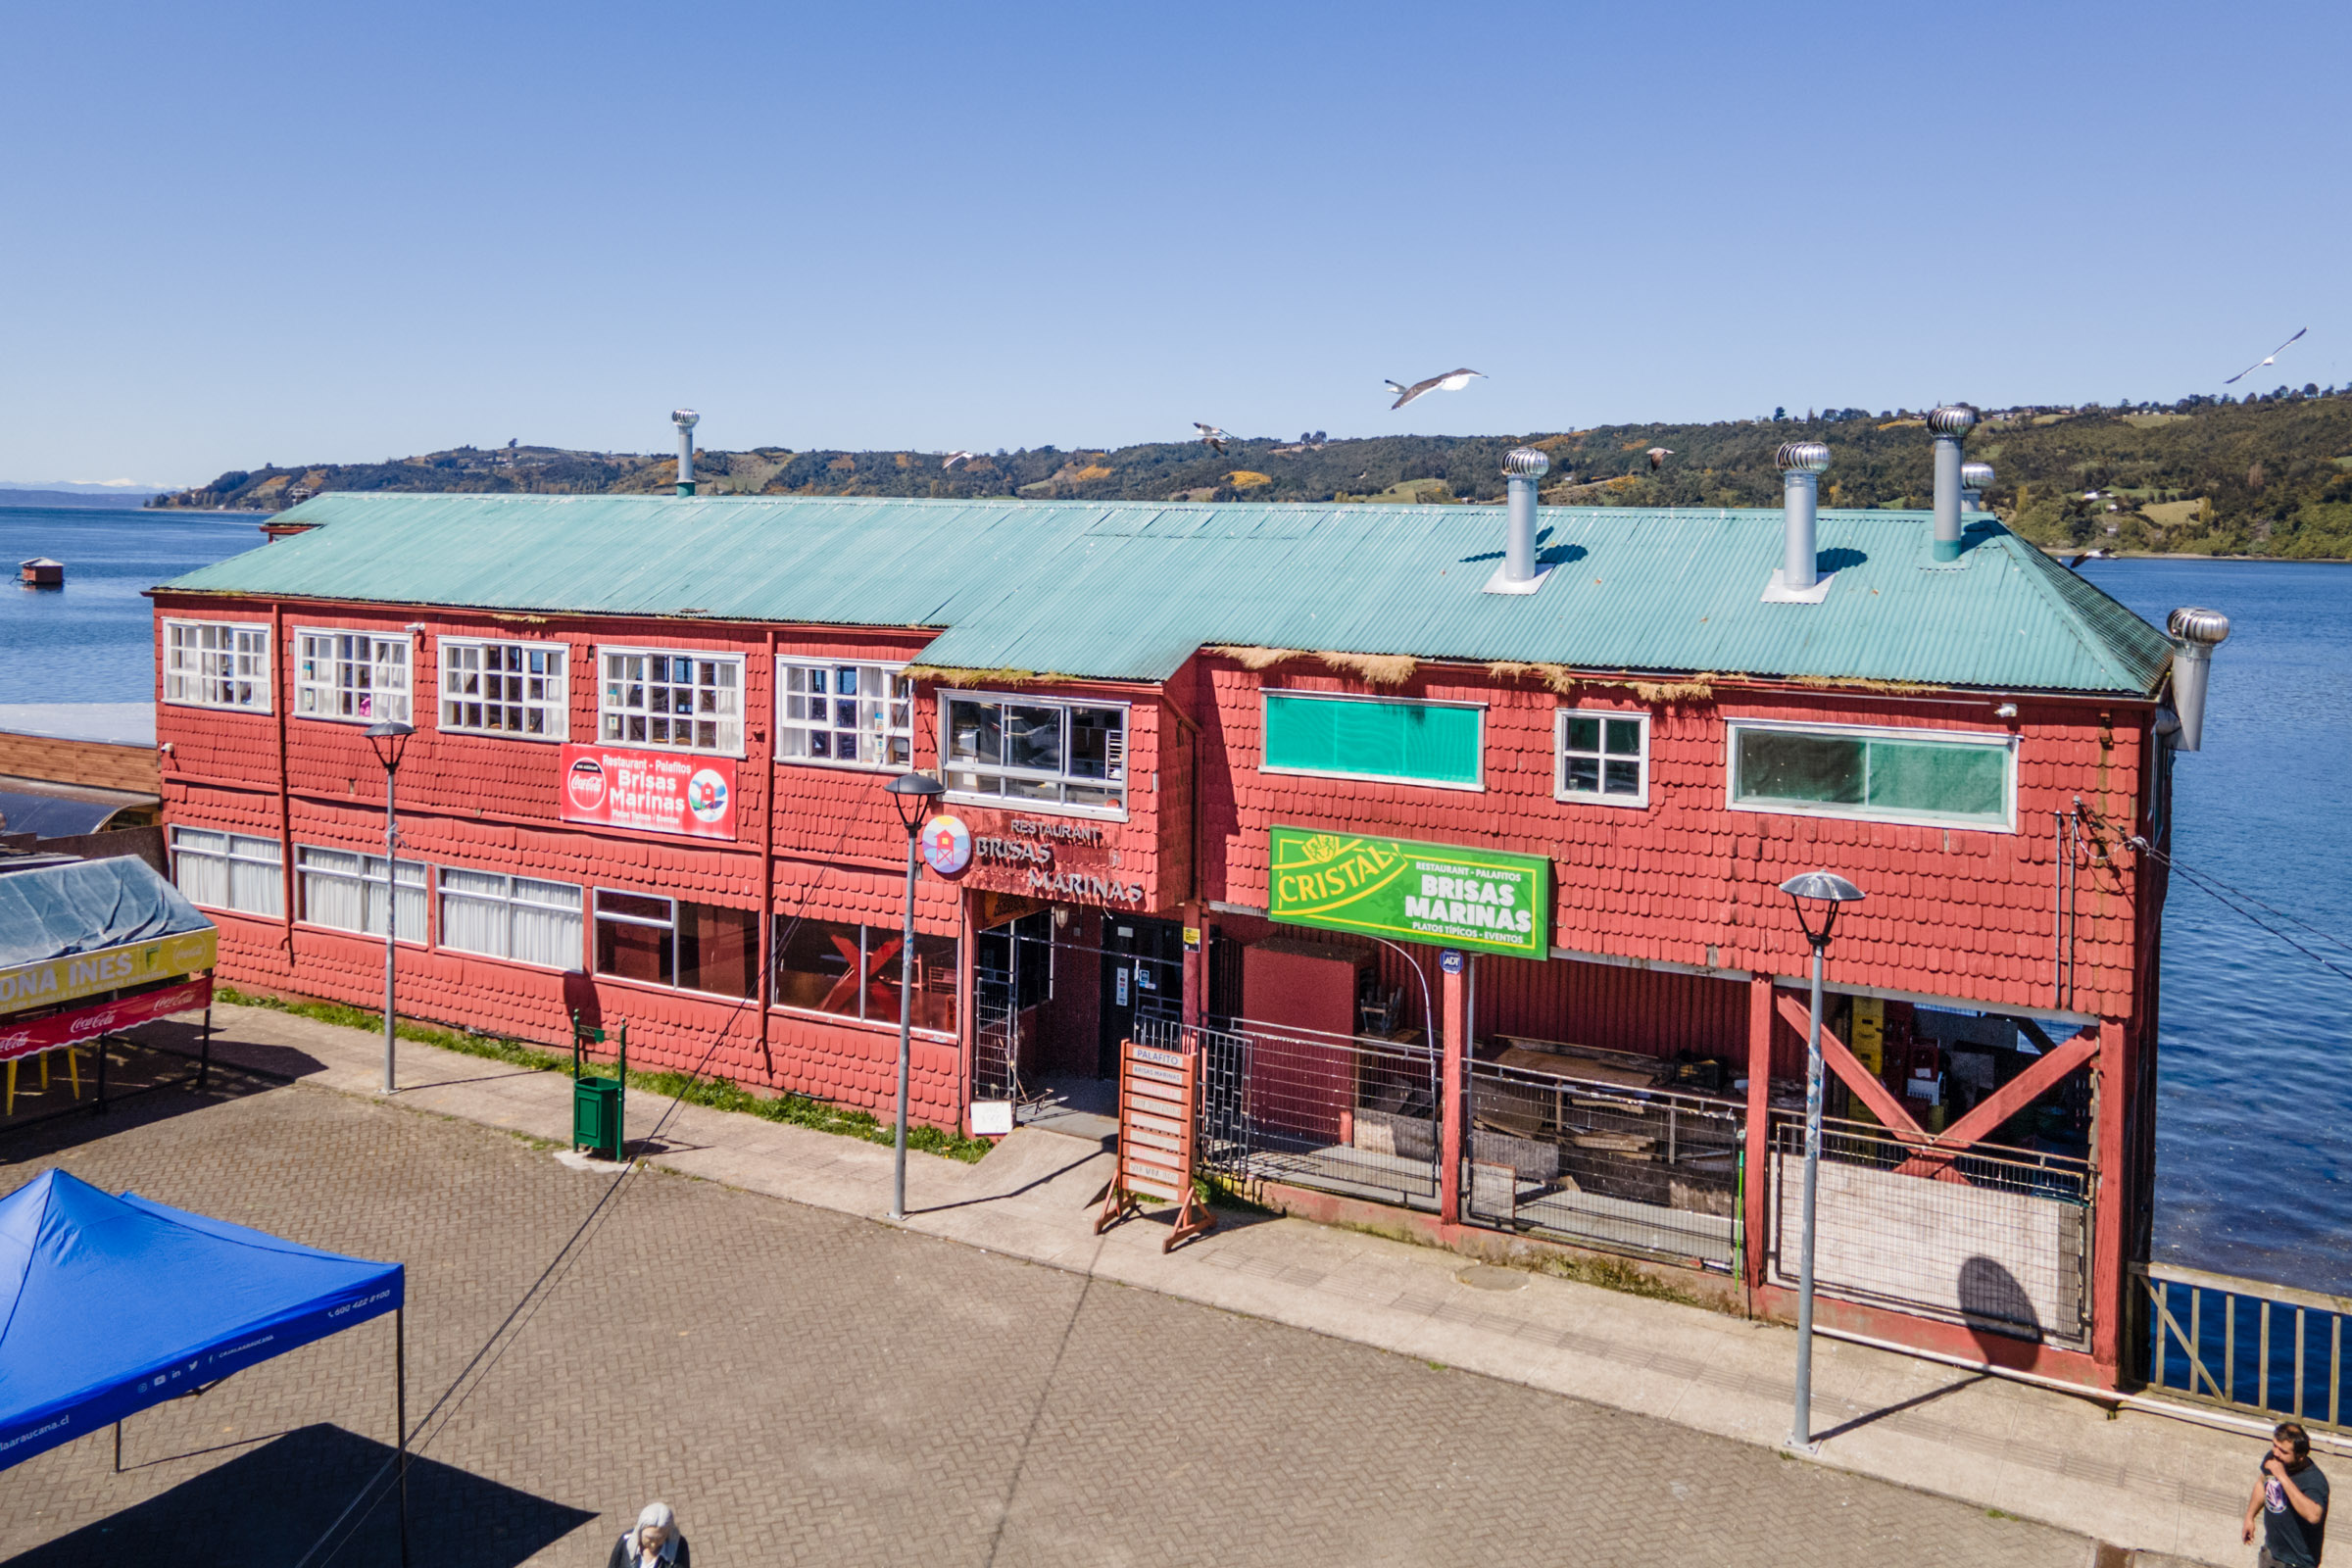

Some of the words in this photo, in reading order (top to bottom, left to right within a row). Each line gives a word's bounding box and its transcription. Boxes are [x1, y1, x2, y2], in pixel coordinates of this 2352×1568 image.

[603, 754, 647, 771] Restaurant
[656, 760, 692, 774] Palafitos
[618, 769, 676, 792] Brisas
[610, 787, 685, 812] Marinas
[1010, 819, 1100, 840] RESTAURANT
[975, 837, 1052, 863] BRISAS
[1278, 845, 1395, 902] CRISTAL
[1415, 861, 1470, 876] RESTAURANT
[1475, 868, 1521, 882] PALAFITOS
[1028, 869, 1143, 903] MARINAS
[1421, 874, 1515, 906] BRISAS
[1405, 896, 1532, 933] MARINAS
[1412, 921, 1443, 933] PLATOS
[1484, 932, 1524, 944] EVENTOS
[69, 953, 133, 988] INES
[1444, 956, 1460, 966] ADT
[71, 1010, 118, 1033] Coca-Cola
[1137, 1050, 1179, 1065] PALAFITO
[334, 1304, 351, 1316] 600
